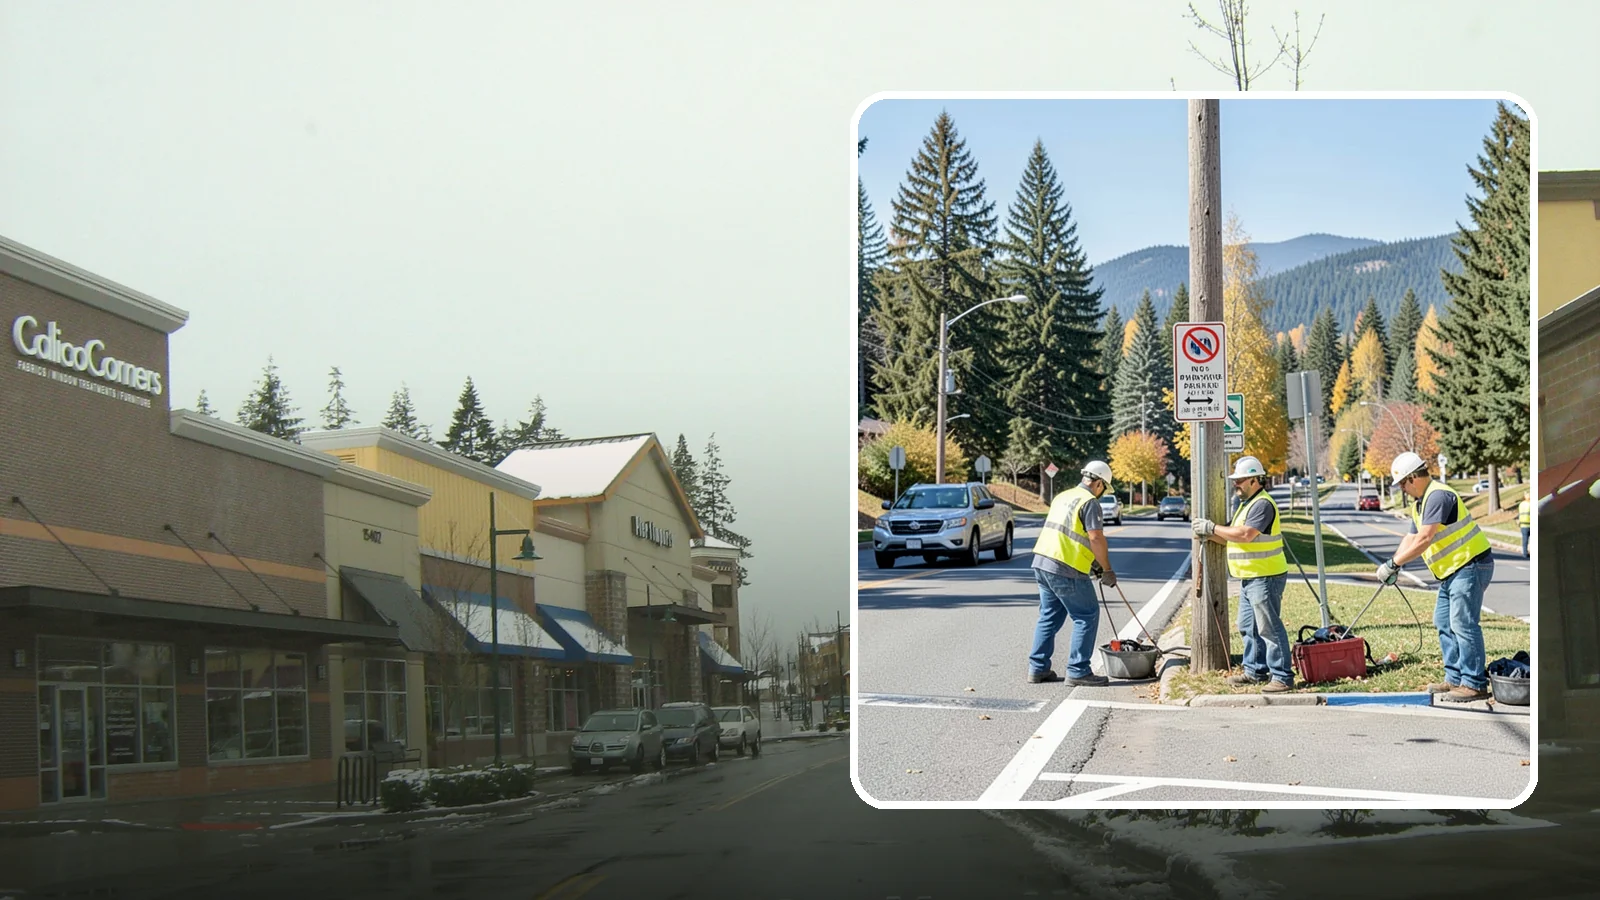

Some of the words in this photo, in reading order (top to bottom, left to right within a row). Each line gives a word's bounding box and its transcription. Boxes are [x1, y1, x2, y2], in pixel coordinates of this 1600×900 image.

[16, 359, 47, 377] FABRICS
[51, 369, 78, 387] WINDOW
[78, 378, 116, 398] TREATMENTS
[119, 391, 151, 409] FURNITURE
